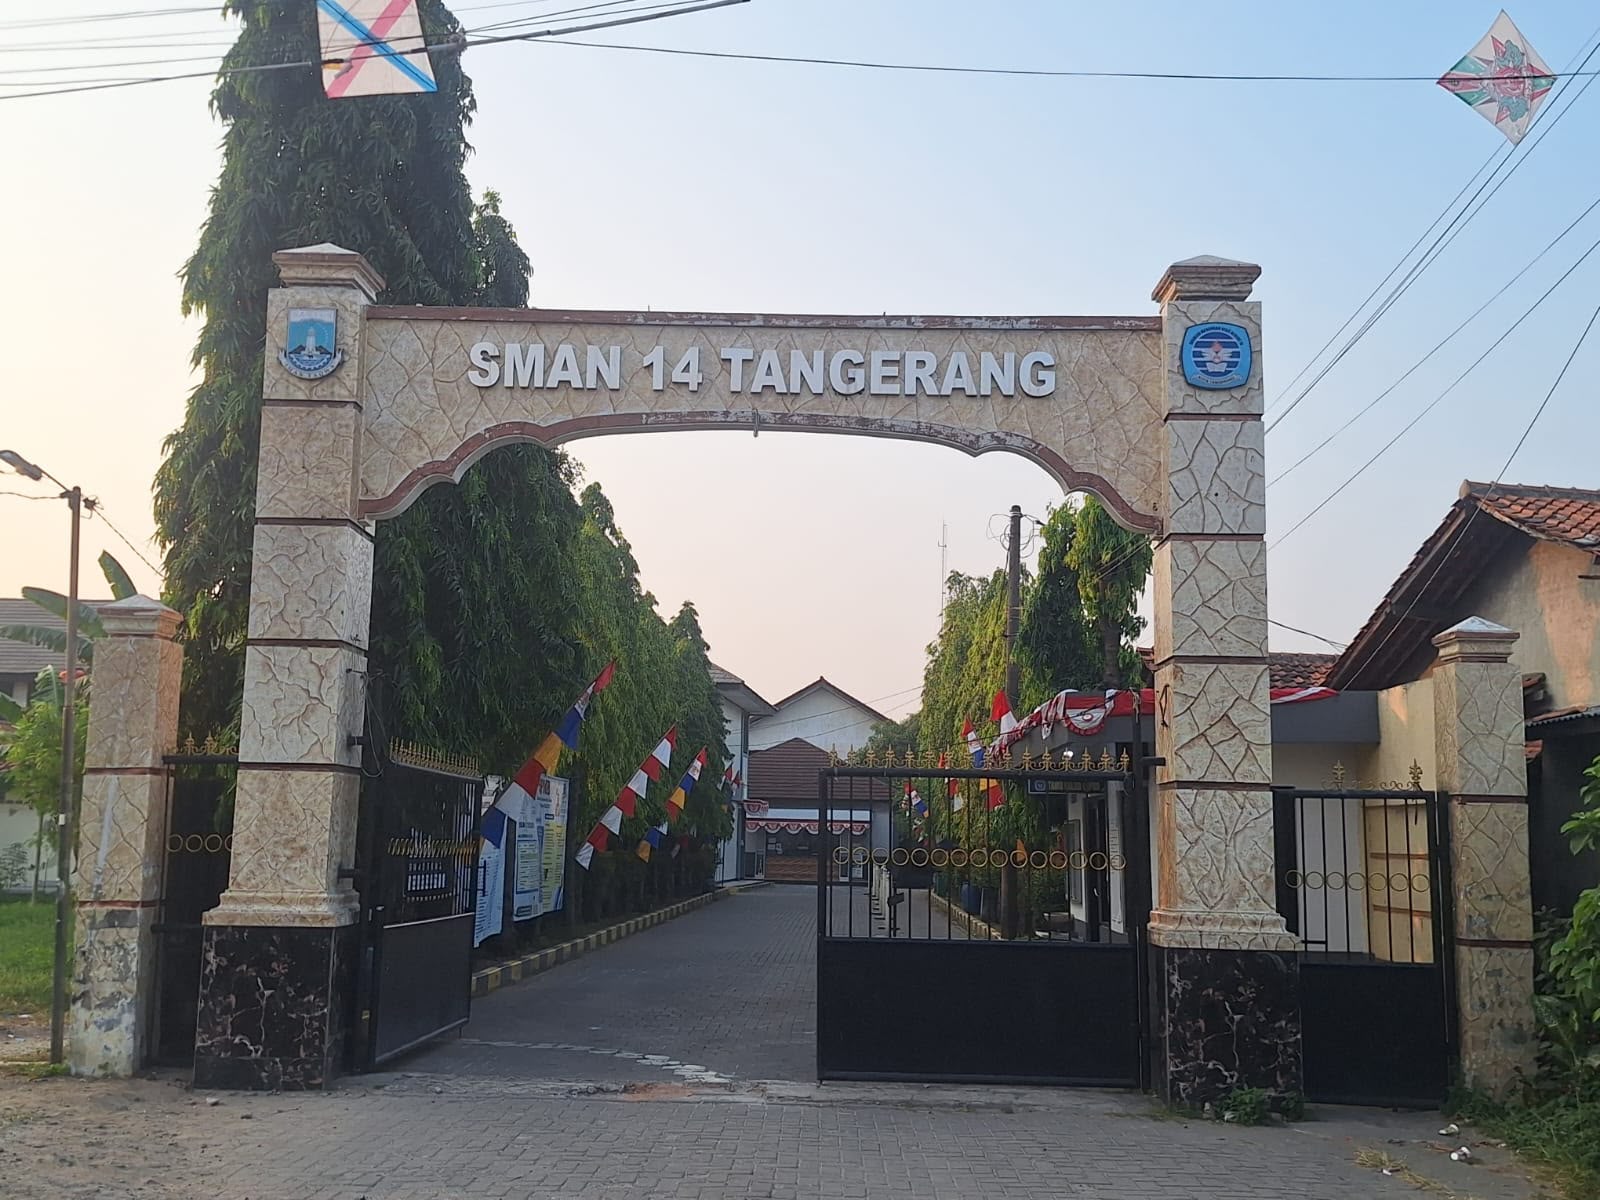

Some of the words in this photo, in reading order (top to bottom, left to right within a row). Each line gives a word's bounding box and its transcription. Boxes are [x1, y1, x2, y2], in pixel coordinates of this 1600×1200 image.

[468, 342, 621, 390] SMAN
[643, 345, 703, 391] 14
[720, 347, 1056, 397] TANGERANG
